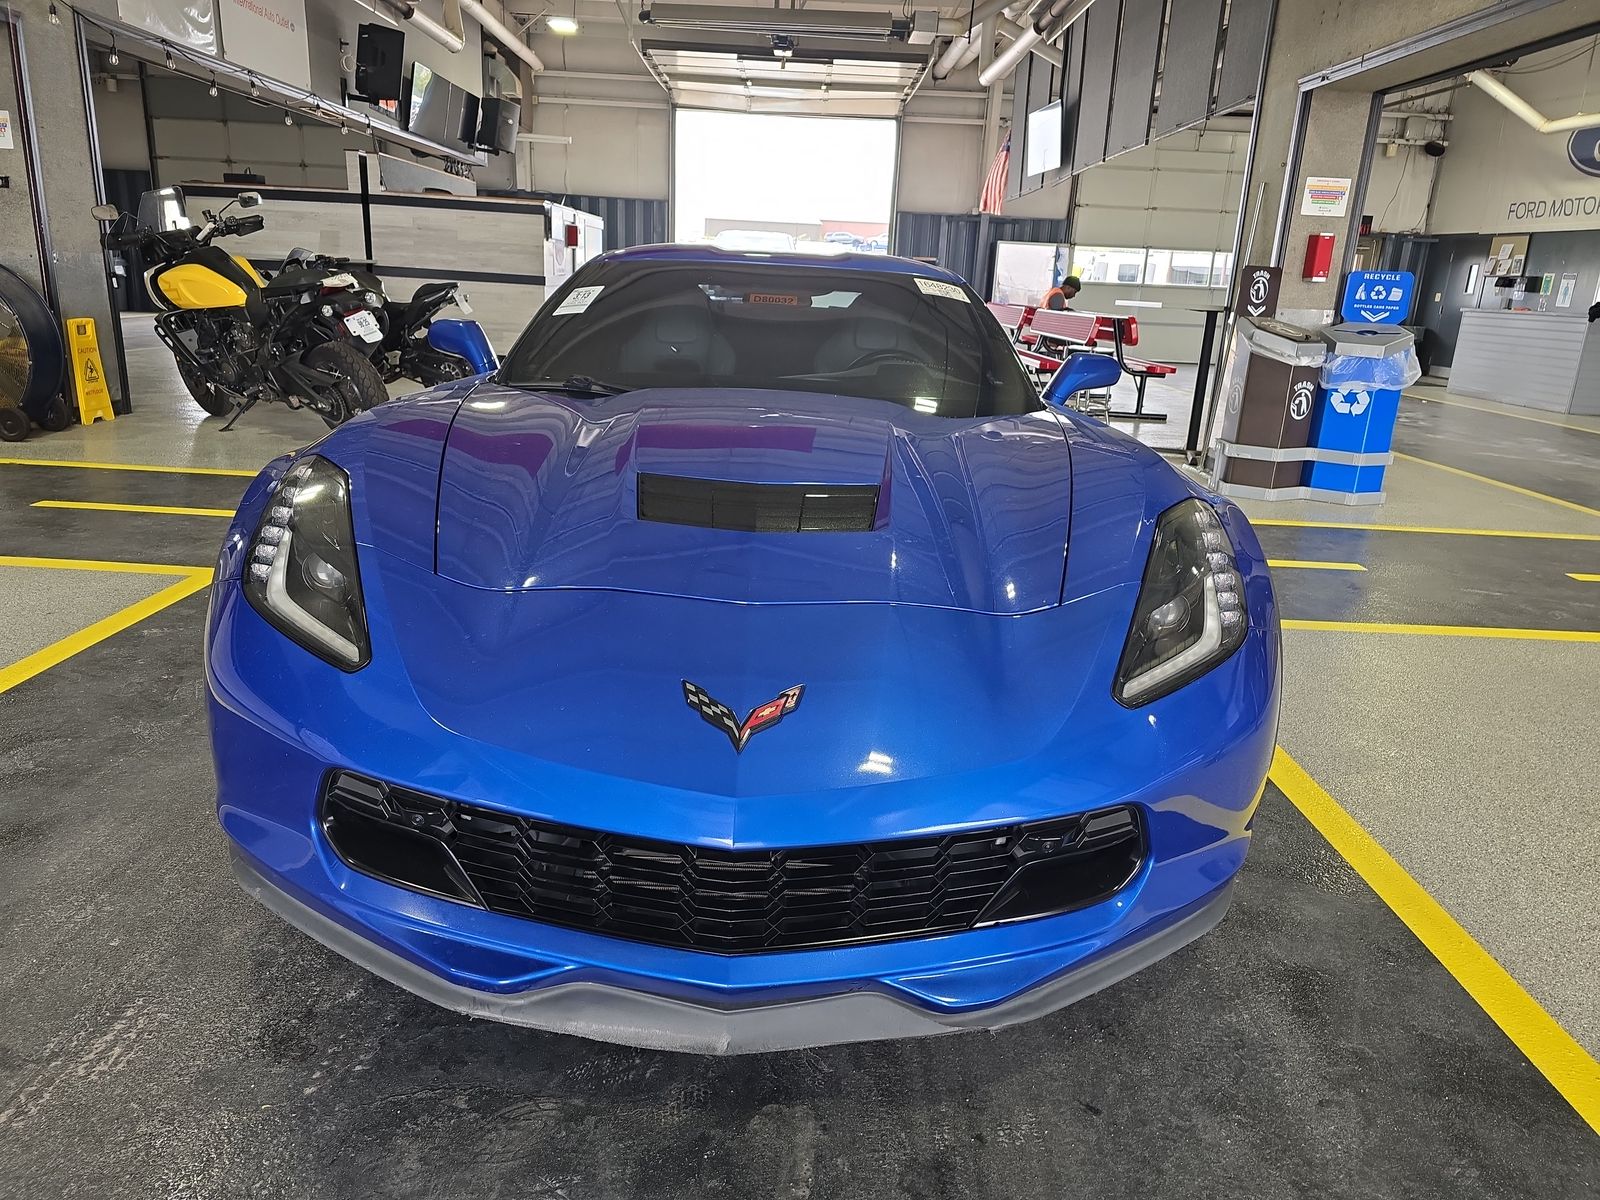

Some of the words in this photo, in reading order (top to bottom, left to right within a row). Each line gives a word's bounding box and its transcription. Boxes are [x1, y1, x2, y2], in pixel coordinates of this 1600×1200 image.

[264, 8, 276, 23] Auto
[1507, 201, 1547, 220] FORD
[1253, 270, 1271, 280] TRASH
[1364, 273, 1401, 281] RECYCLE
[753, 295, 795, 305] D80032
[77, 346, 98, 354] CAUTION
[1294, 380, 1315, 392] TRASH
